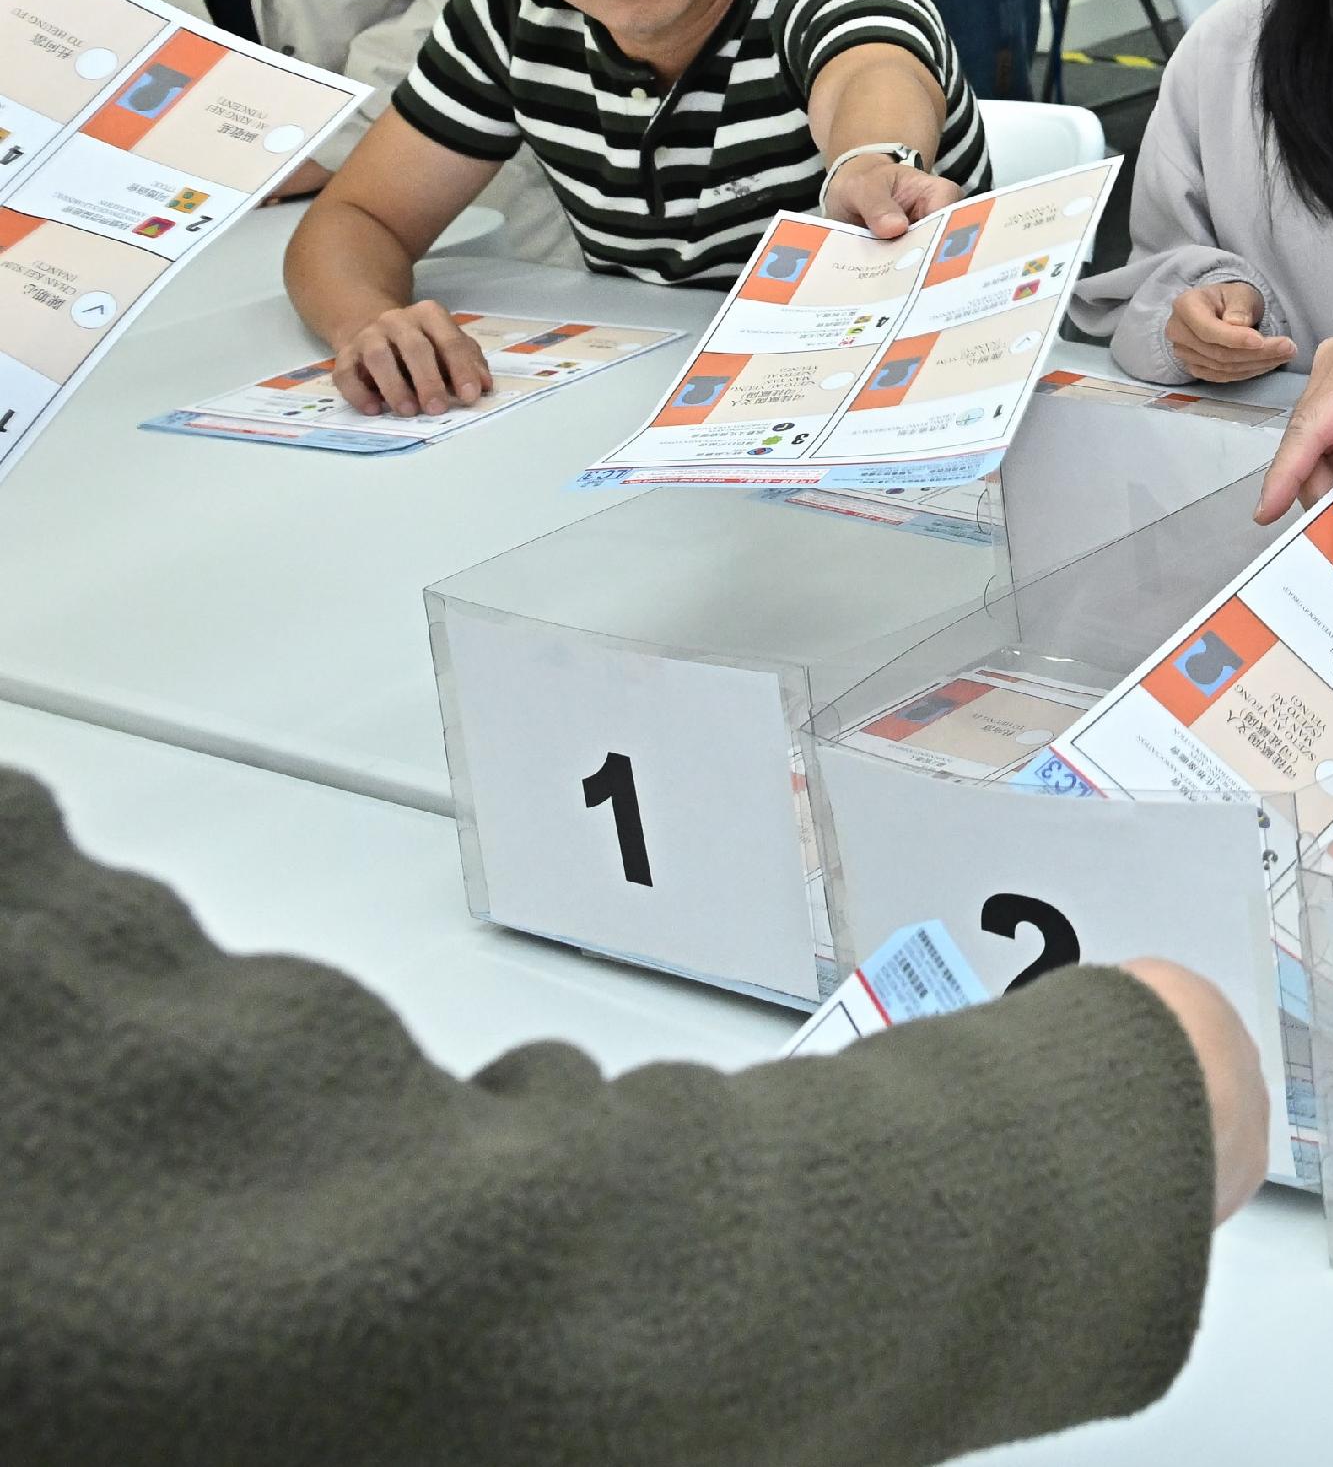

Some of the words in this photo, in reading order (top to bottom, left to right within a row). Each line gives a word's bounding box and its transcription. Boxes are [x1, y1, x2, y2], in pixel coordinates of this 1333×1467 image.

[183, 213, 213, 233] 2
[875, 316, 889, 327] 4
[790, 433, 808, 445] 3
[1232, 683, 1269, 717] YEUNG
[1270, 691, 1288, 707] AU
[1267, 703, 1289, 723] YAN
[1267, 716, 1283, 731] AU
[1285, 705, 1322, 740] (SZETO
[1288, 693, 1328, 732] YEUNG)
[1282, 729, 1316, 762] SZETO
[1289, 723, 1314, 747] MAN
[1037, 759, 1064, 782] 3
[583, 753, 653, 887] 1
[981, 893, 1080, 998] 2
